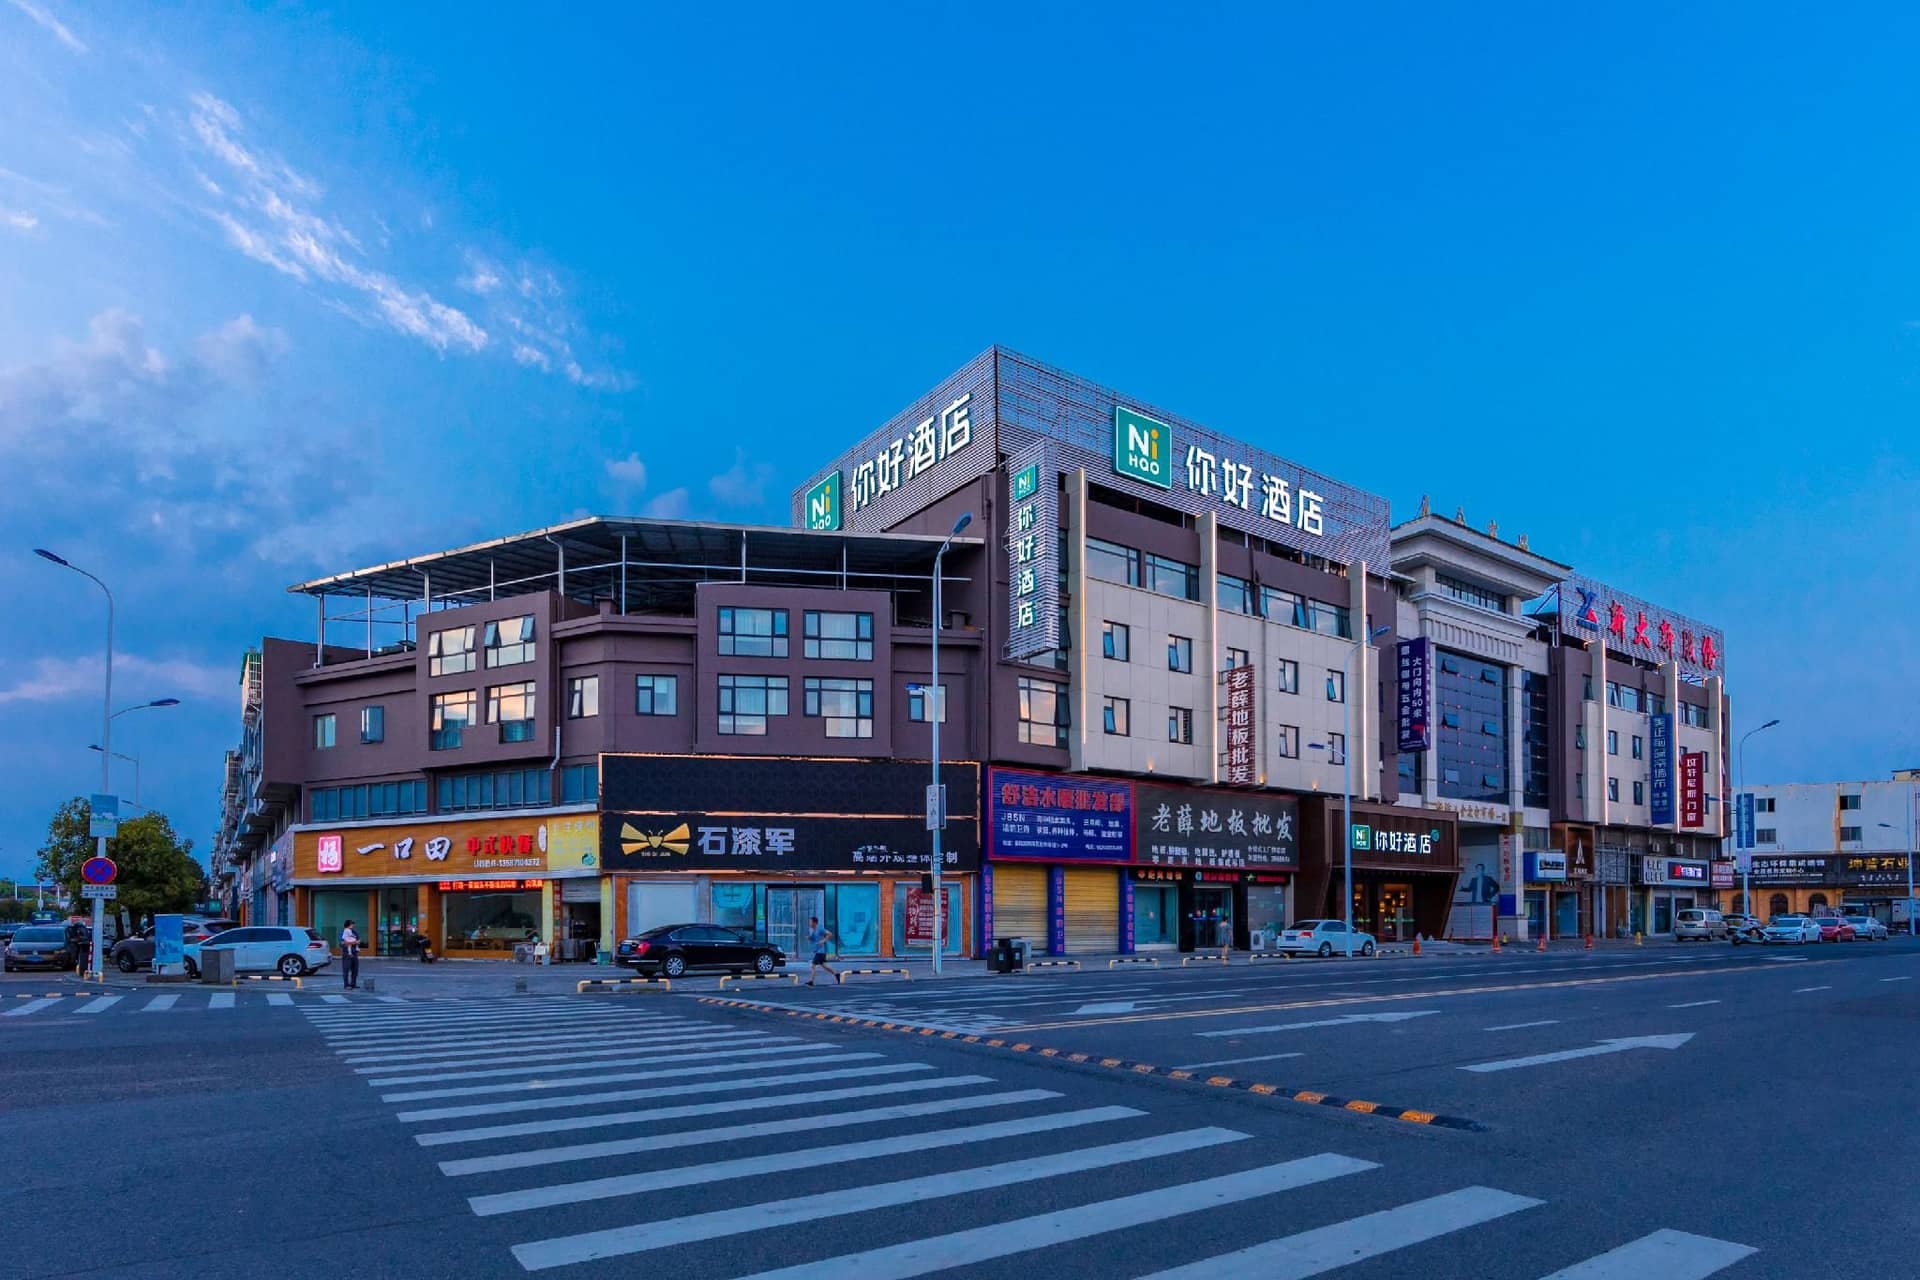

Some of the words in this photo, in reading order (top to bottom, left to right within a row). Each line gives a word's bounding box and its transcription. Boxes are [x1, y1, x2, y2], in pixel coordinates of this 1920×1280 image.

[852, 393, 971, 511] 你好酒店
[1129, 423, 1159, 460] Ni
[812, 485, 831, 522] Ni
[1186, 445, 1324, 536] 你好酒店
[1017, 503, 1034, 629] 你好酒店
[1231, 671, 1249, 783] 老薛地板批发
[697, 826, 795, 856] 石漆军
[1151, 803, 1293, 841] 老薛地板批发
[1375, 830, 1431, 854] 你好酒店
